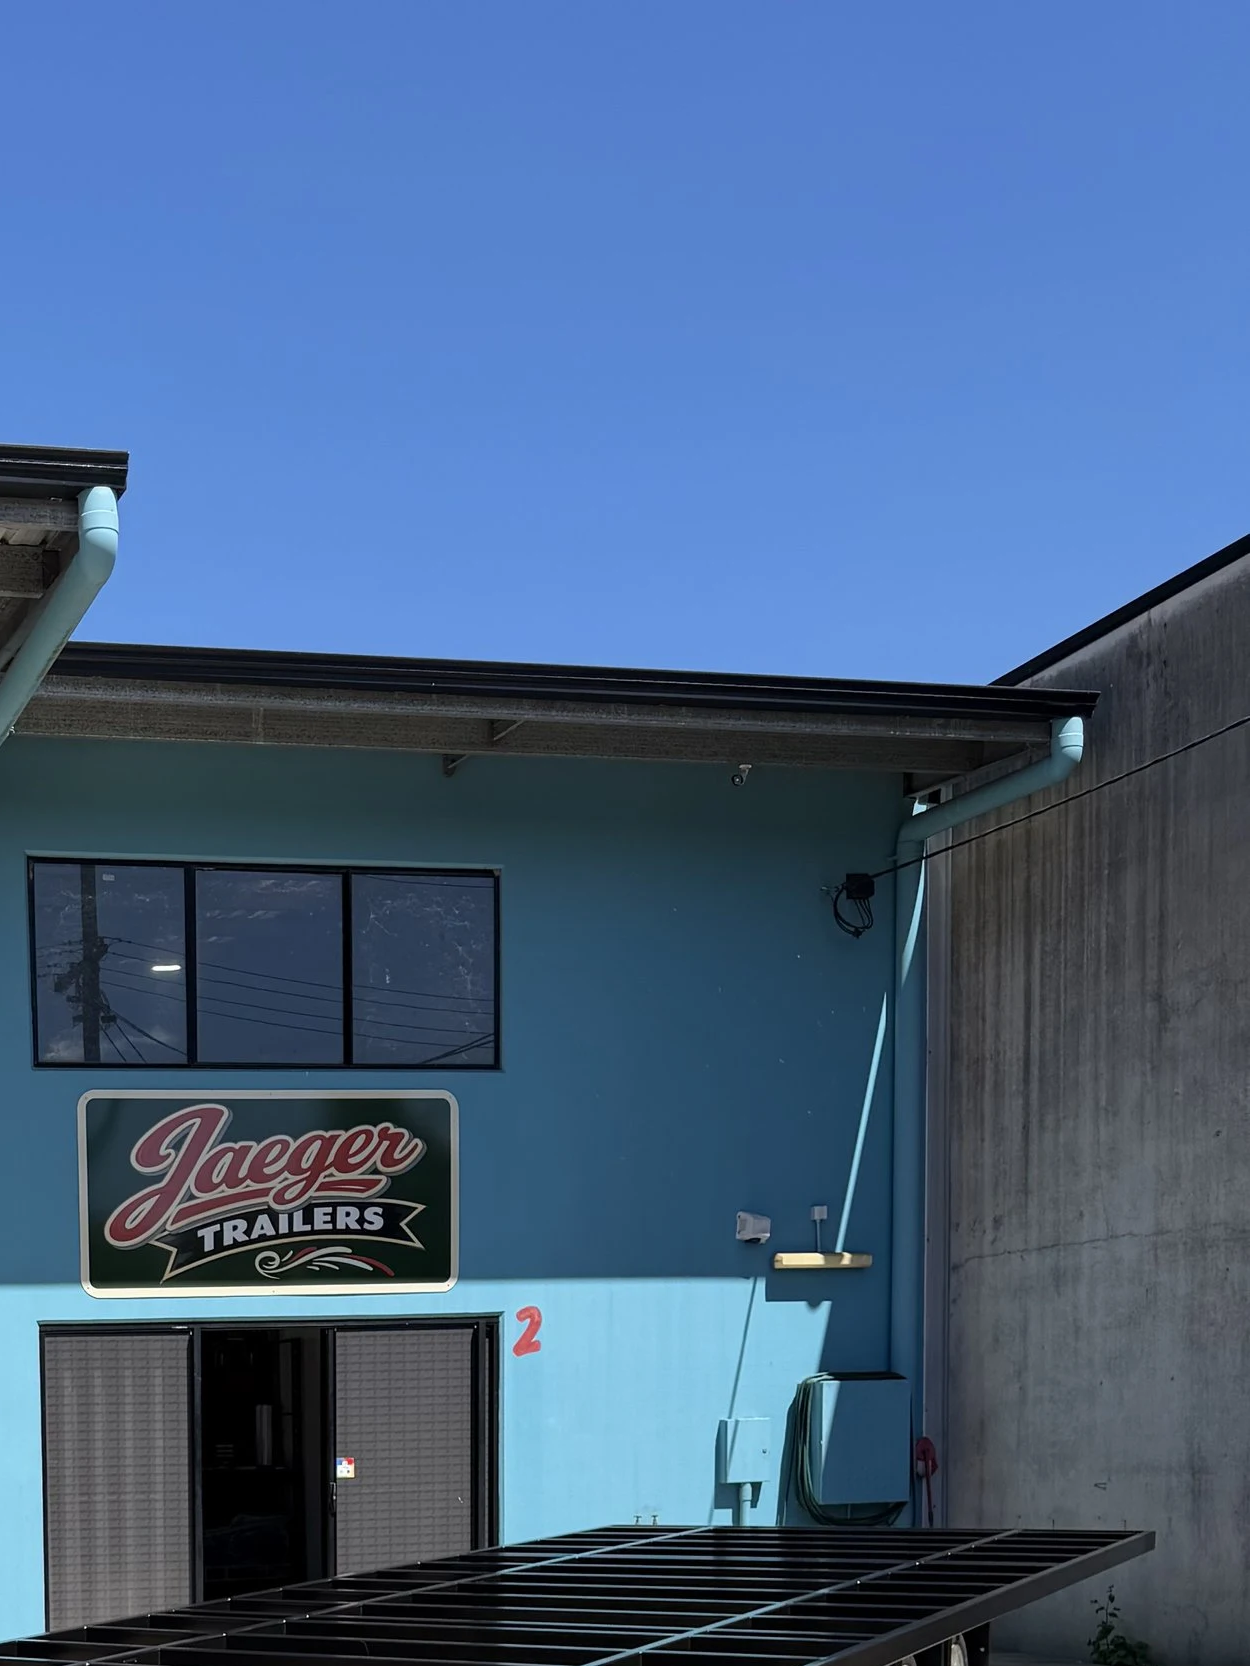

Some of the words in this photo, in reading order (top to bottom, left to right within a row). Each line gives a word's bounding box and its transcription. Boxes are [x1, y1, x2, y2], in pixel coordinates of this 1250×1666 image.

[104, 1103, 427, 1250] Jaeger
[197, 1205, 384, 1252] TRAILERS
[512, 1306, 541, 1357] 2
